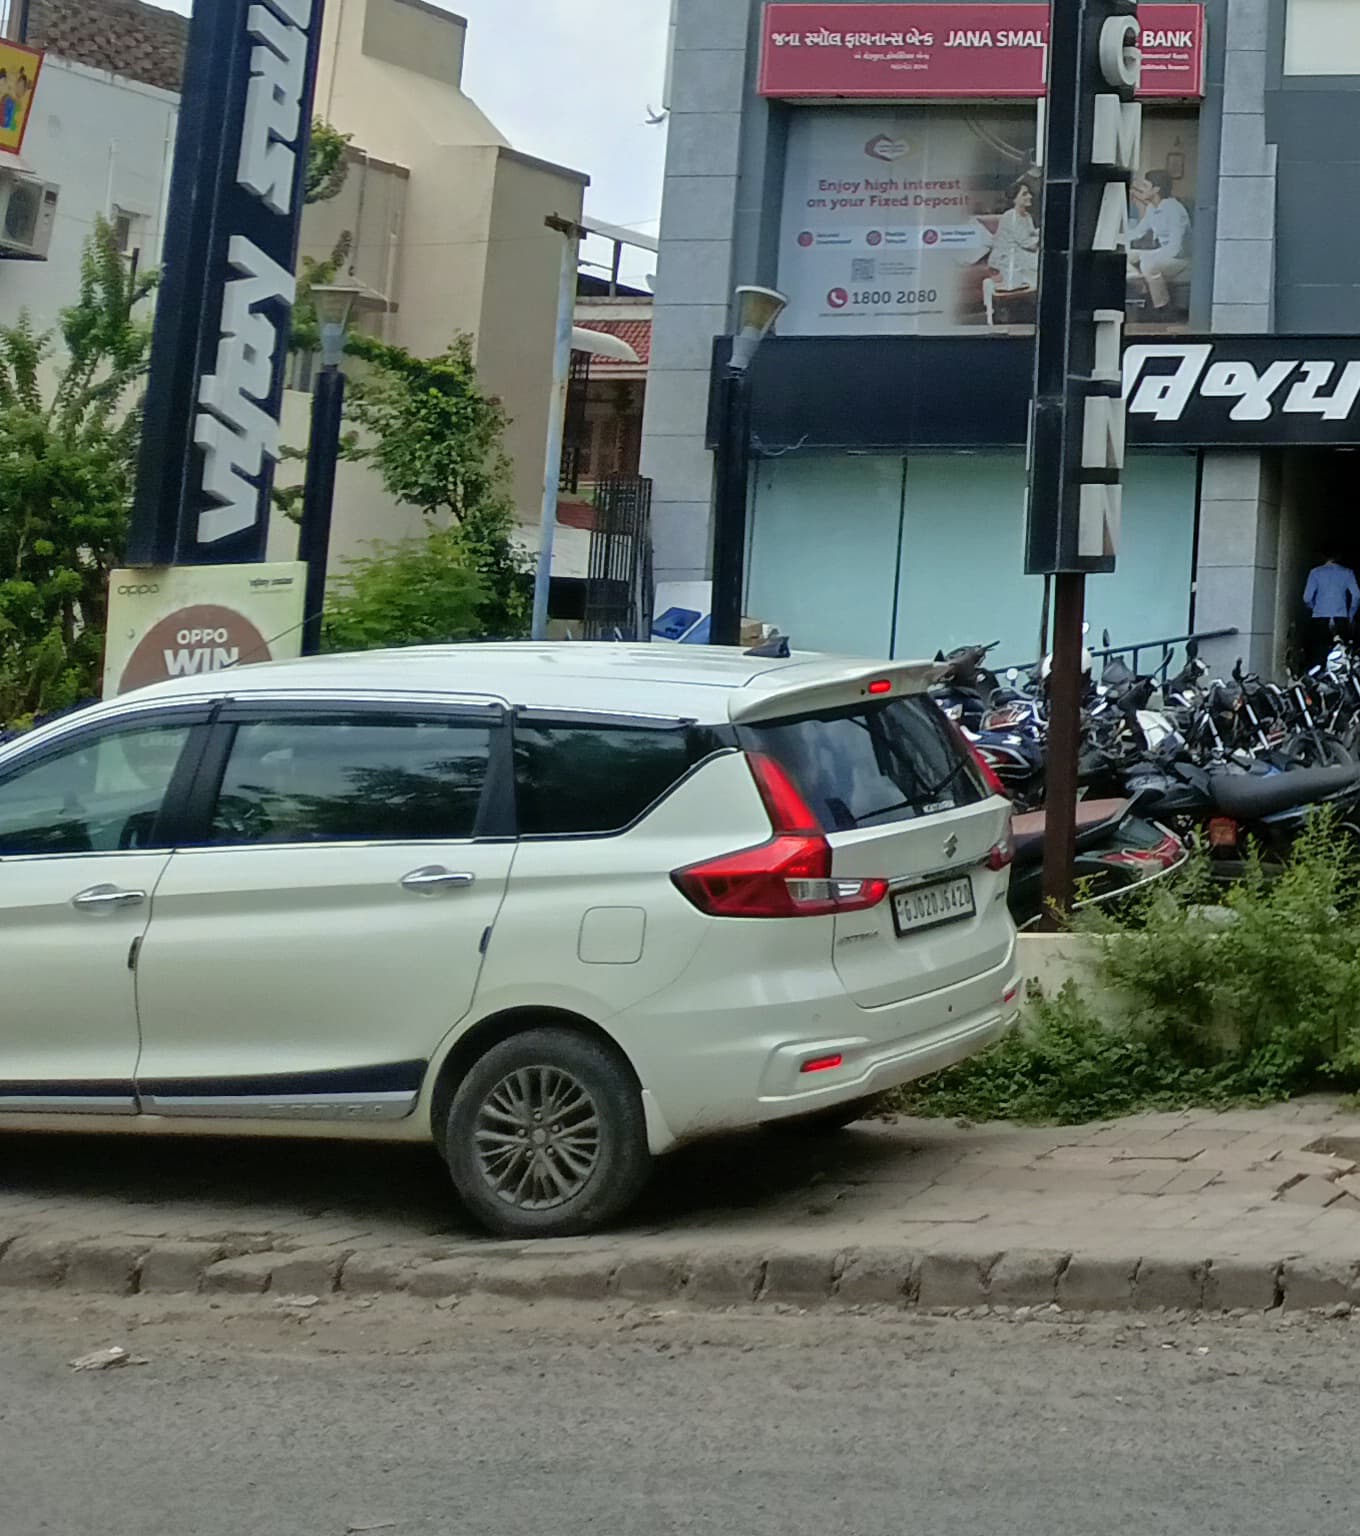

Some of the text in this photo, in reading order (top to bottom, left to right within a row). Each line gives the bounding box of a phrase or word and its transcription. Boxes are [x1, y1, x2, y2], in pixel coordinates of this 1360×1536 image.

[943, 30, 1193, 47] JANA SMAL BANK
[818, 178, 961, 196] Enjoy high interest
[806, 194, 969, 210] on your Fixed Deposit
[851, 288, 938, 305] 1800 2080
[176, 628, 228, 645] OPPO
[163, 647, 241, 676] WIN
